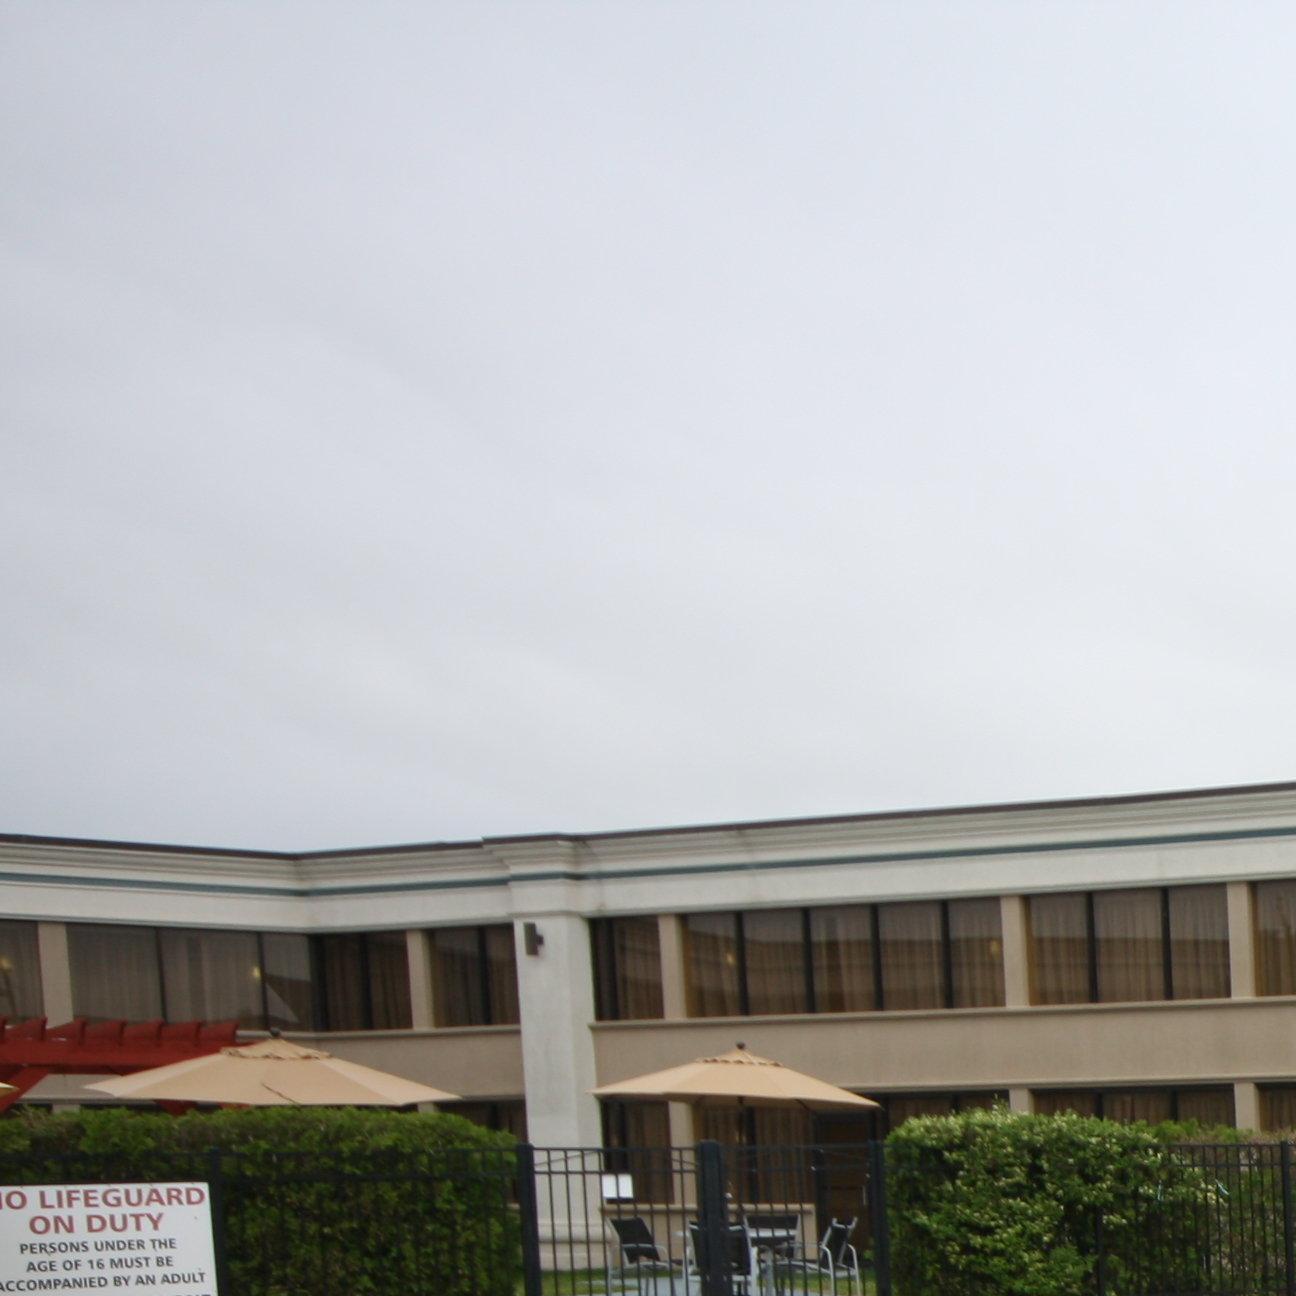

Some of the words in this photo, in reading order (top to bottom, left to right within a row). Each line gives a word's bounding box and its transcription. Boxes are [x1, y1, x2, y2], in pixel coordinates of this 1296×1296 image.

[0, 1190, 27, 1210] O
[39, 1187, 206, 1209] LIFEGUARD
[29, 1215, 75, 1235] ON
[86, 1212, 164, 1233] DUTY
[20, 1241, 89, 1255] PERSONS
[94, 1239, 145, 1252] UNDER
[149, 1238, 177, 1250] THE
[26, 1260, 57, 1273] AGE
[63, 1259, 82, 1271] OF
[87, 1258, 105, 1270] 16
[110, 1256, 151, 1269] MUST
[156, 1256, 174, 1267] BE
[0, 1276, 108, 1292] ACCOMPANIED
[113, 1275, 131, 1287] BY
[135, 1274, 156, 1286] AN
[160, 1272, 206, 1285] ADULT
